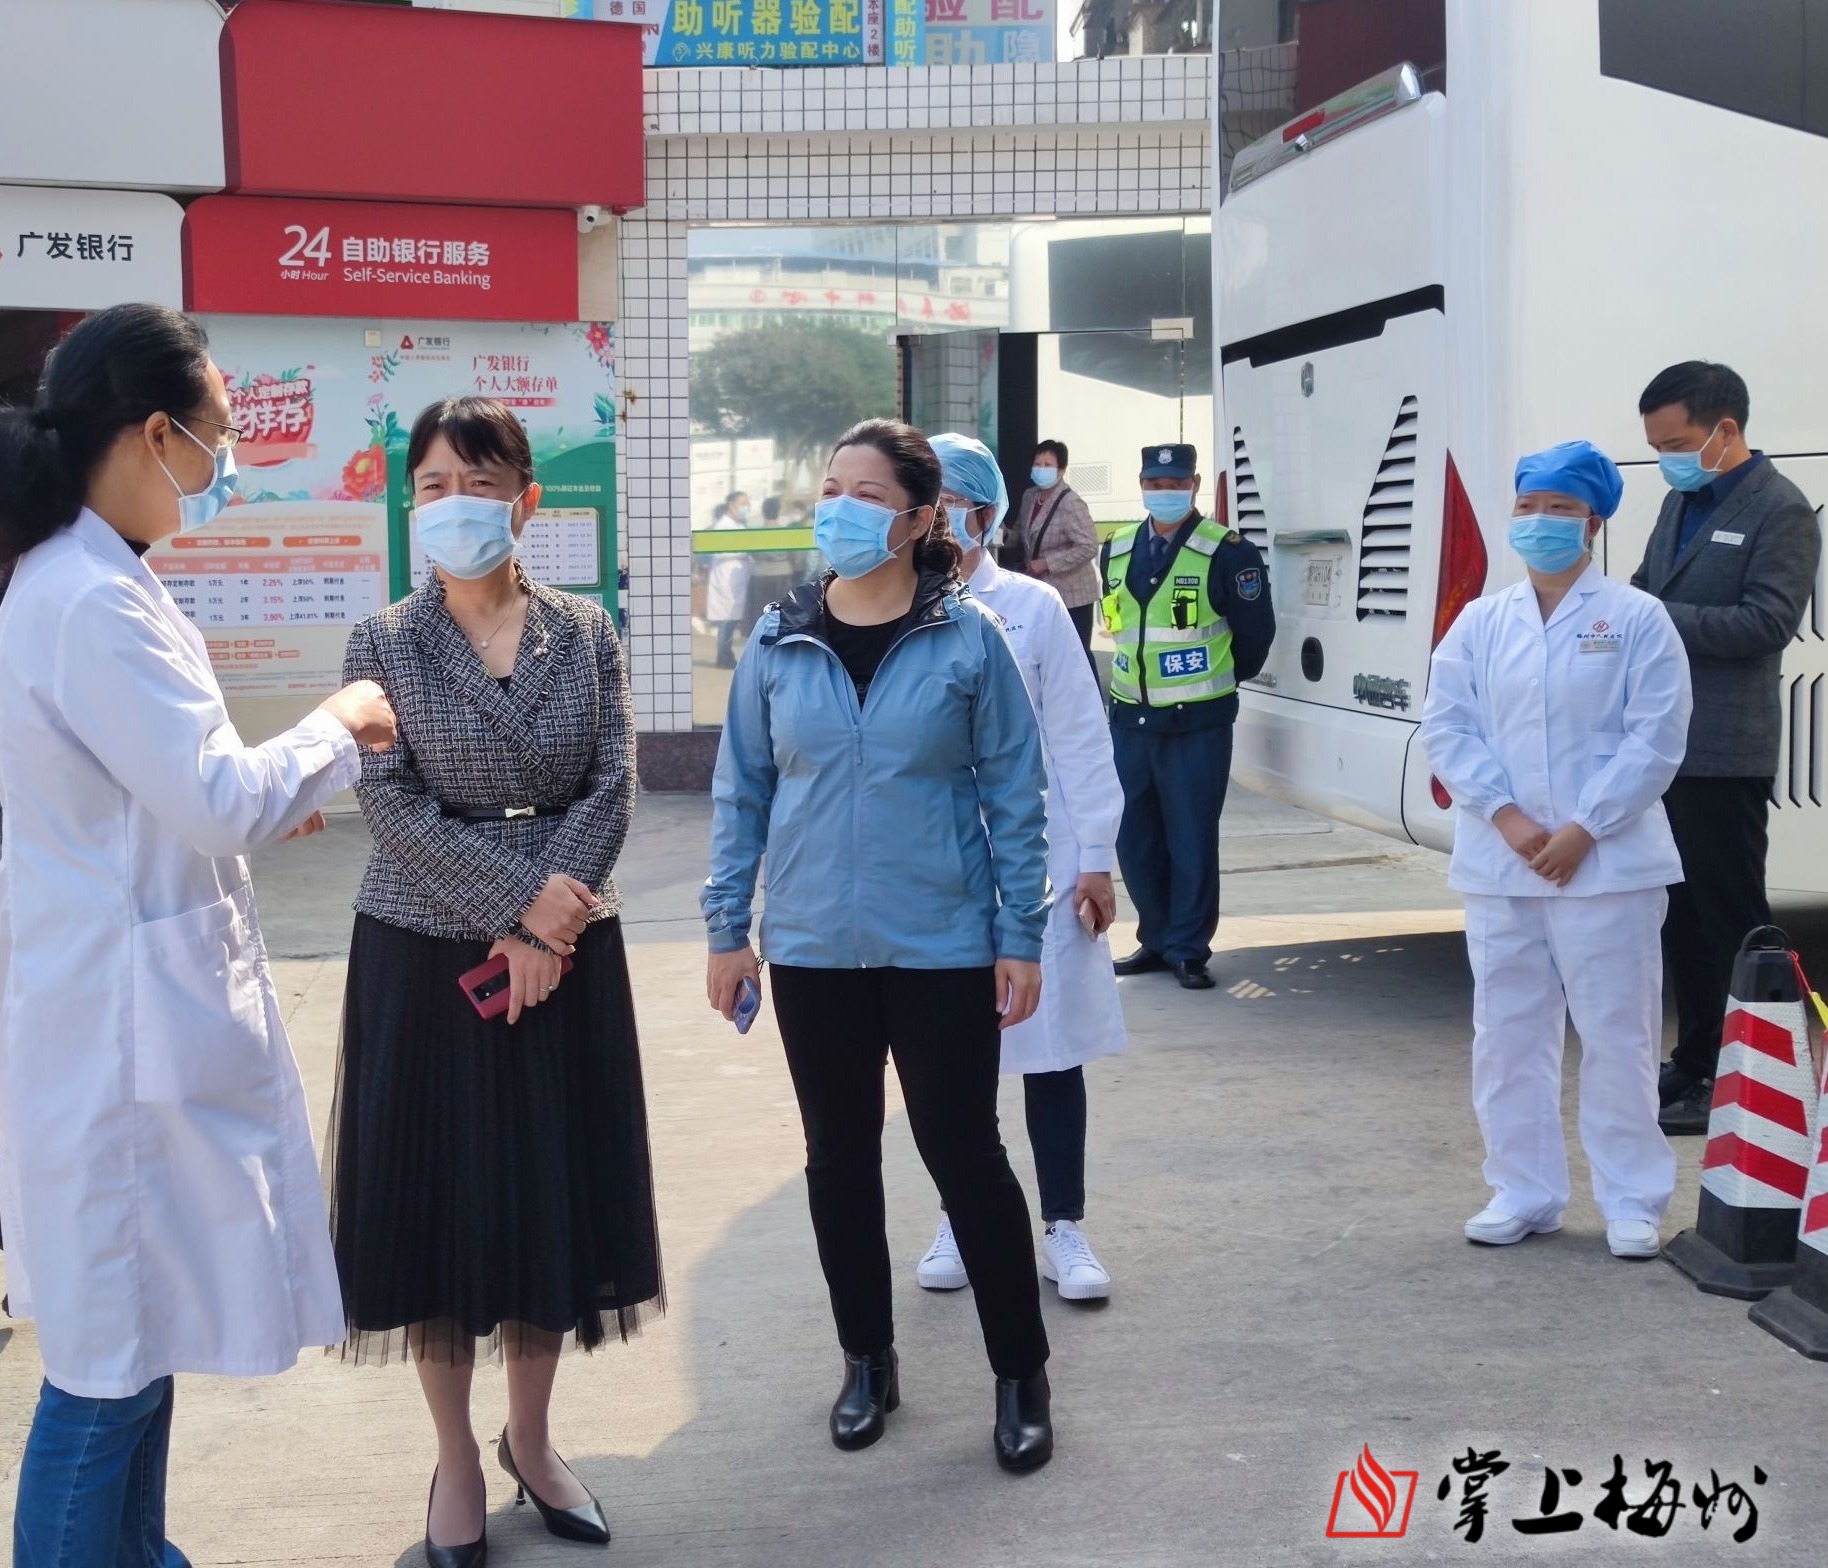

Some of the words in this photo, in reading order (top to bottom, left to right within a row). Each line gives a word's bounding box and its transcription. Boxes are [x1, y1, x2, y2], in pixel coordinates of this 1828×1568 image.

[671, 0, 861, 36] 助听器验配
[696, 41, 861, 60] 兴康听力验配中心
[17, 231, 134, 262] 广发银行
[278, 224, 332, 267] 24
[342, 236, 490, 267] 自助银行服务
[281, 270, 300, 280] 小时
[302, 270, 328, 281] Hour
[343, 267, 430, 284] Self-Service
[433, 271, 491, 290] Banking
[472, 354, 530, 372] 广发银行
[474, 375, 558, 393] 个人大额存单
[1165, 651, 1204, 673] 保安
